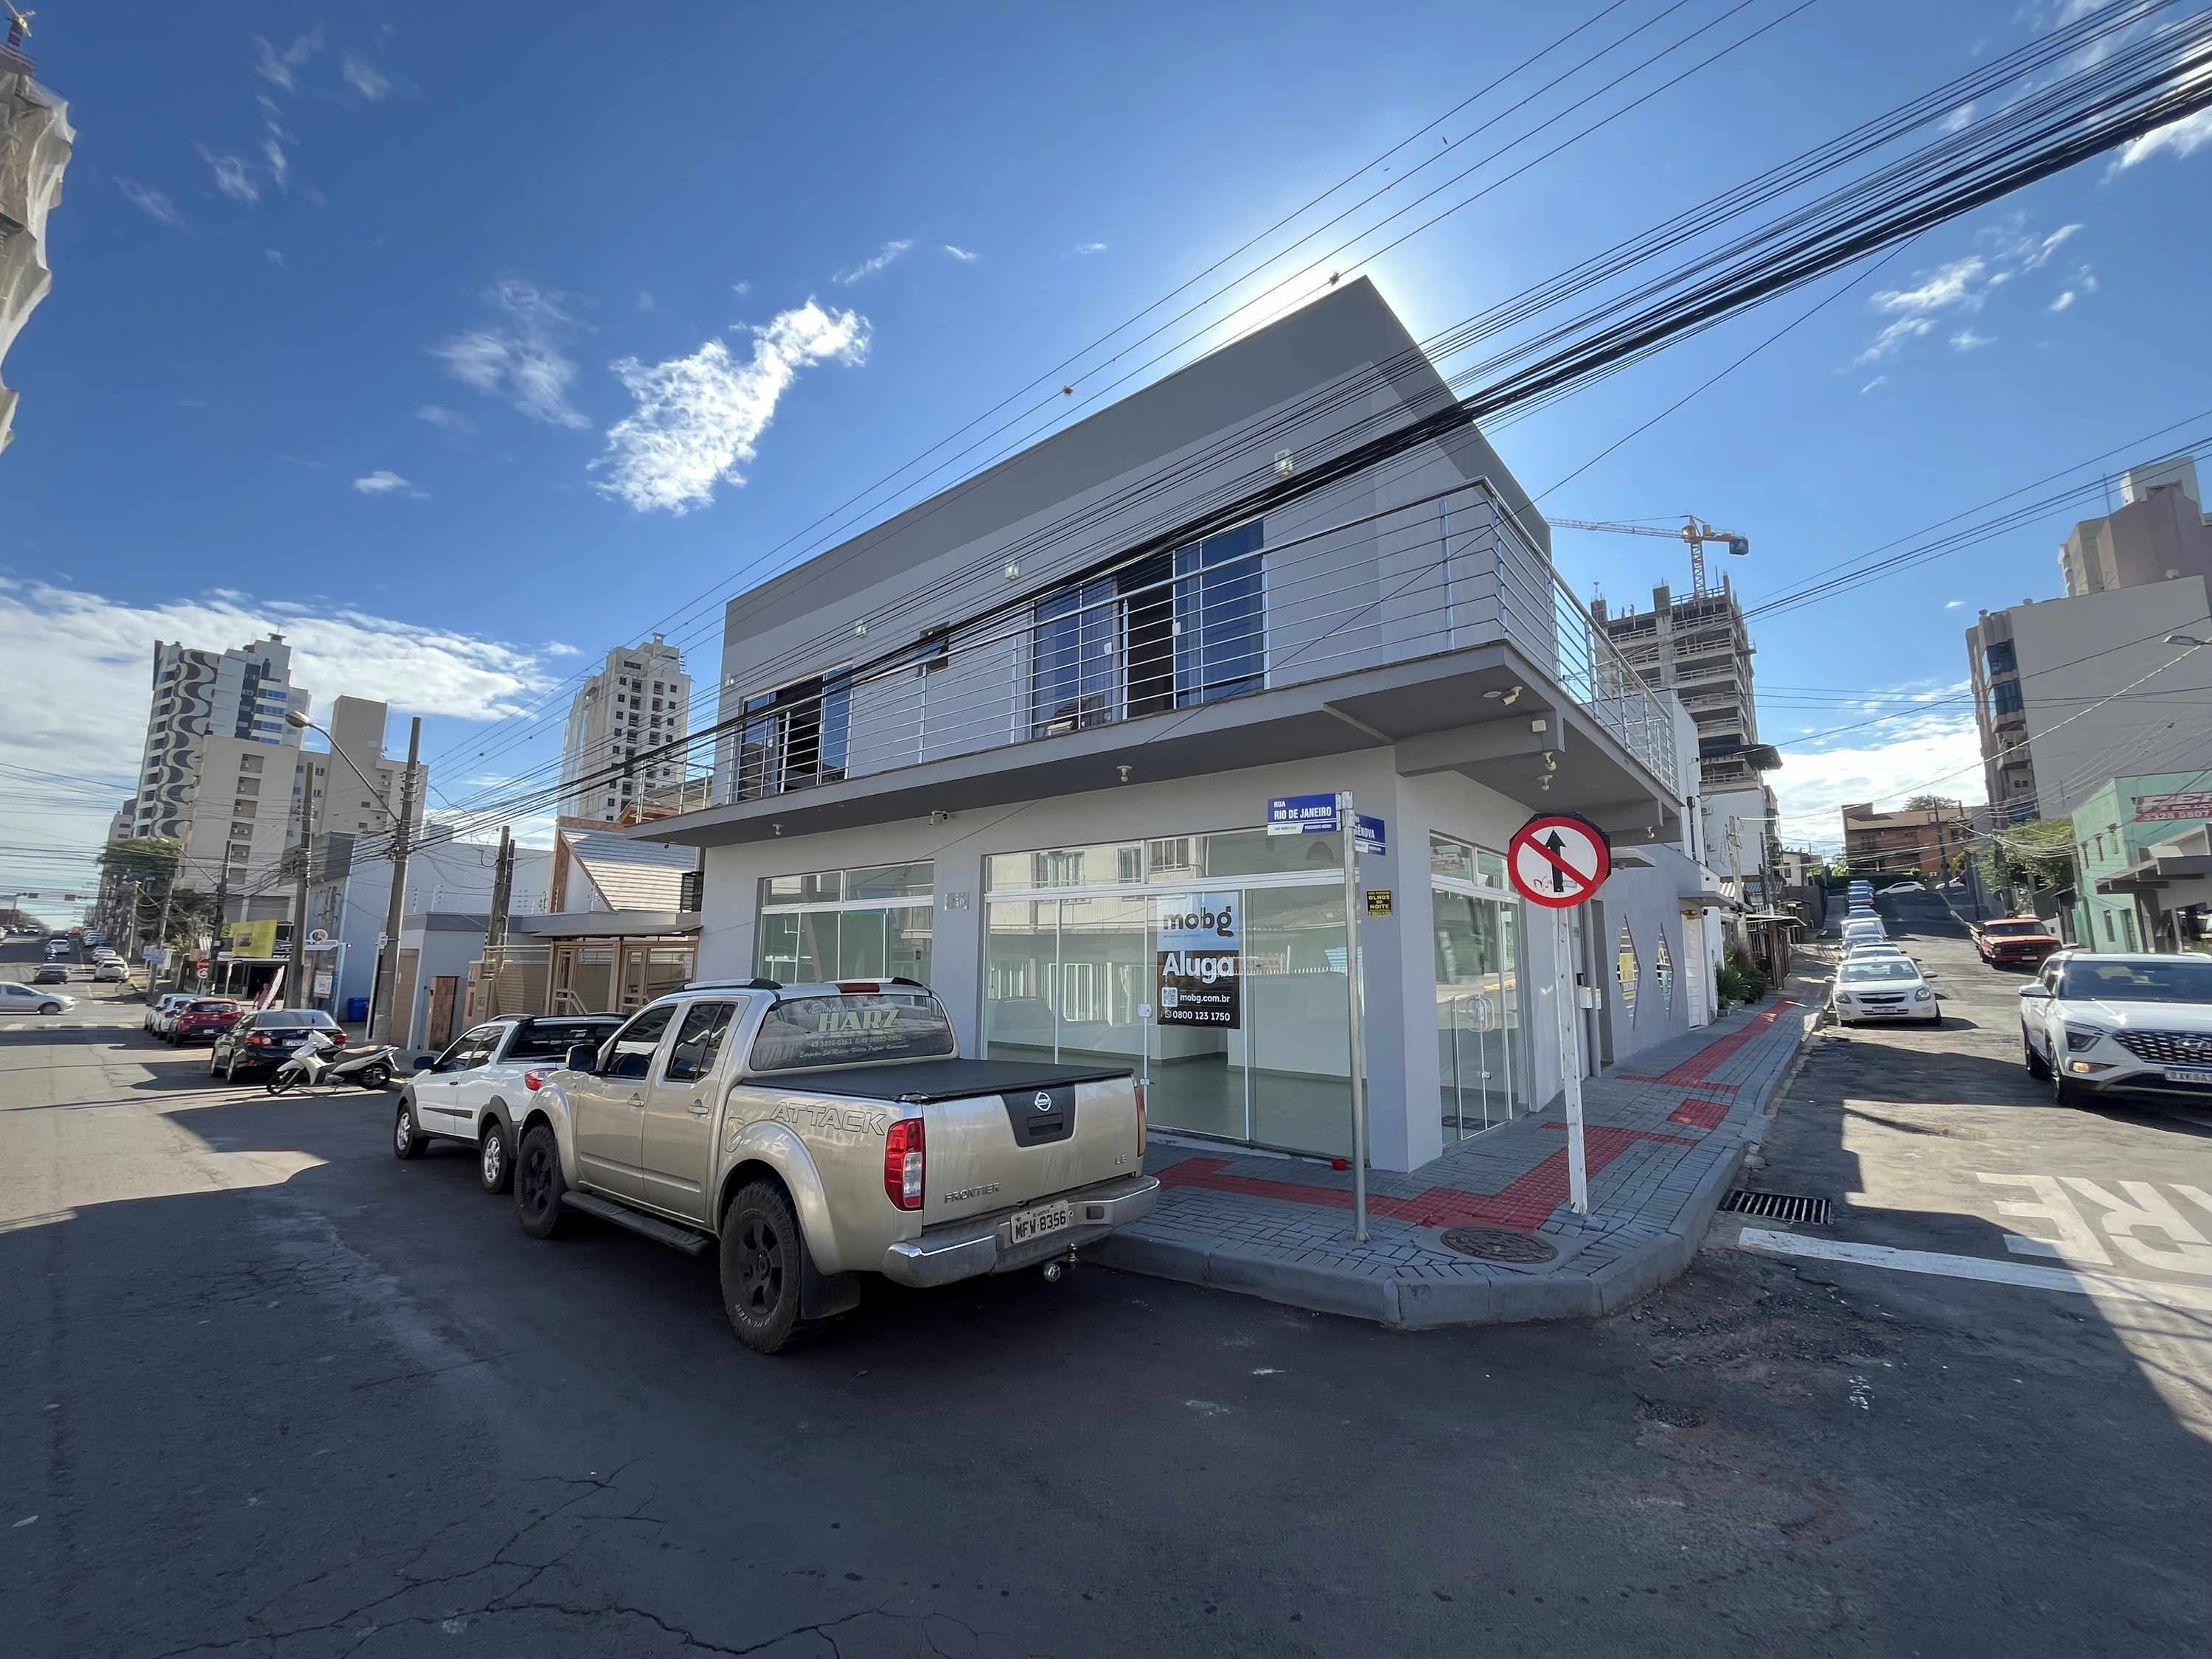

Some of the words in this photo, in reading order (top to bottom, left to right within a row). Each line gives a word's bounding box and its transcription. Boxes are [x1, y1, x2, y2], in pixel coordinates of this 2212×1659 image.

[1273, 810, 1287, 820] RIO
[1288, 809, 1299, 819] DE
[1299, 806, 1332, 818] JANEIRO
[1163, 905, 1234, 938] mobg
[1162, 950, 1234, 984] Aluga
[1180, 993, 1231, 1004] mobg.com.br
[818, 1009, 900, 1033] HARZ
[1172, 1010, 1193, 1020] 0800
[1194, 1011, 1208, 1020] 123
[1211, 1012, 1231, 1021] 1750
[770, 1102, 886, 1135] ATTACK
[1114, 1155, 1127, 1165] LE
[944, 1182, 1000, 1204] FRONTIER
[1015, 1210, 1066, 1240] MFW-8356
[735, 1303, 764, 1328] HUNTER
